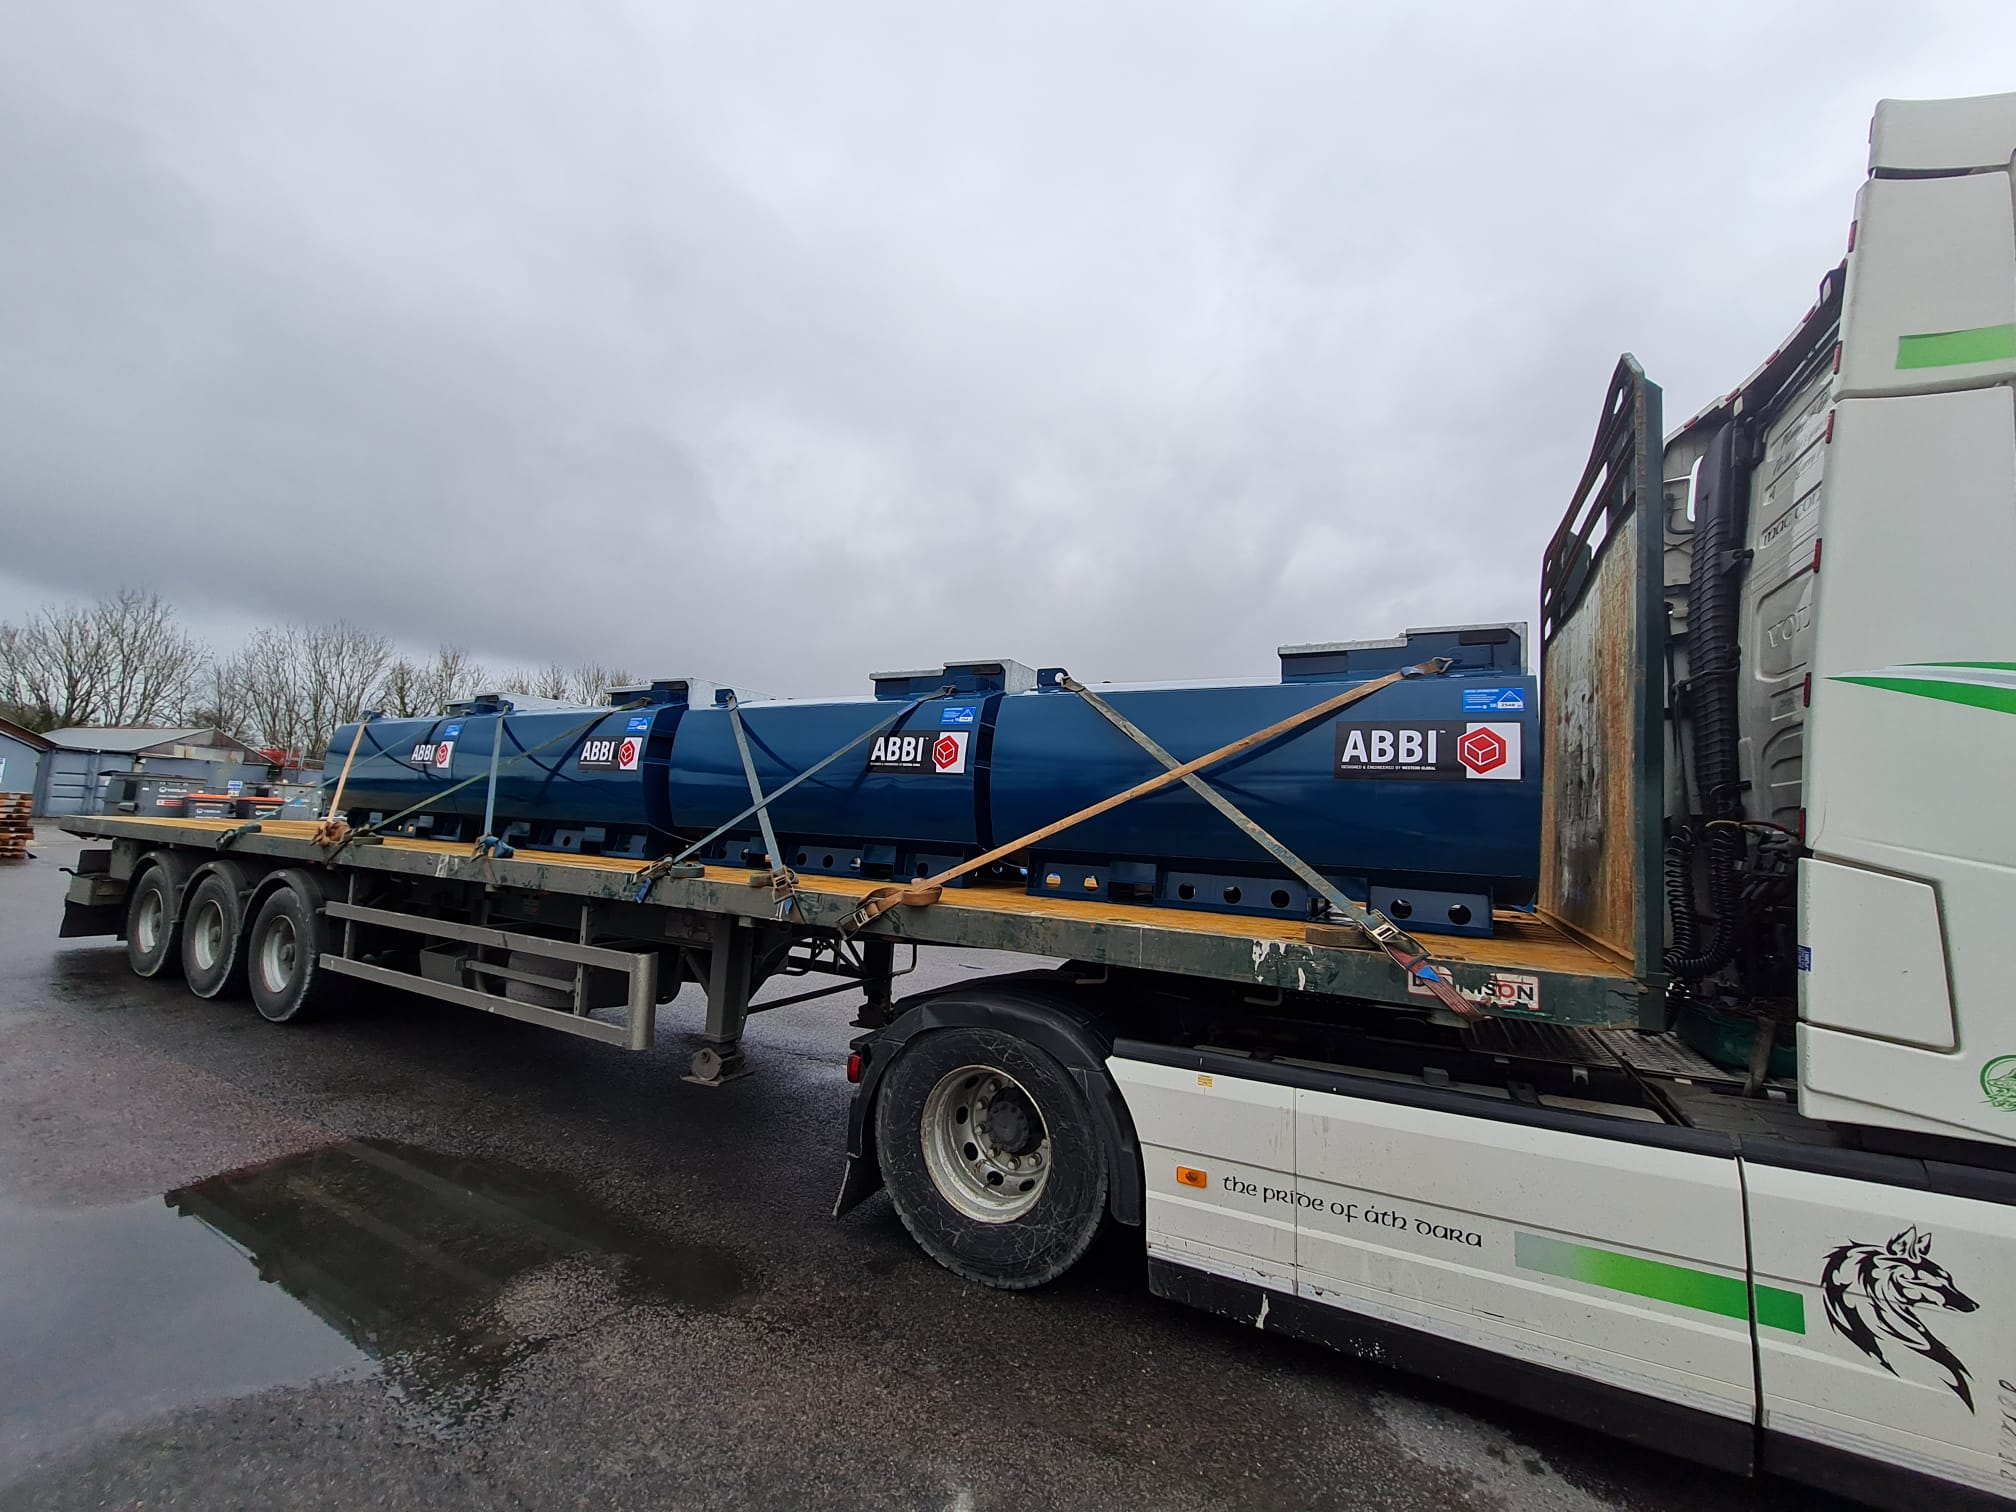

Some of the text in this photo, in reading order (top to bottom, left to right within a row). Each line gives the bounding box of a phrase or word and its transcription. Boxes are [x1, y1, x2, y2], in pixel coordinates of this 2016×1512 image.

[411, 744, 436, 761] ABBI
[580, 741, 615, 761] ABBI
[870, 736, 924, 762] ABBI
[1341, 730, 1437, 764] ABBI
[1222, 1176, 1258, 1197] the
[1330, 1202, 1359, 1223] of
